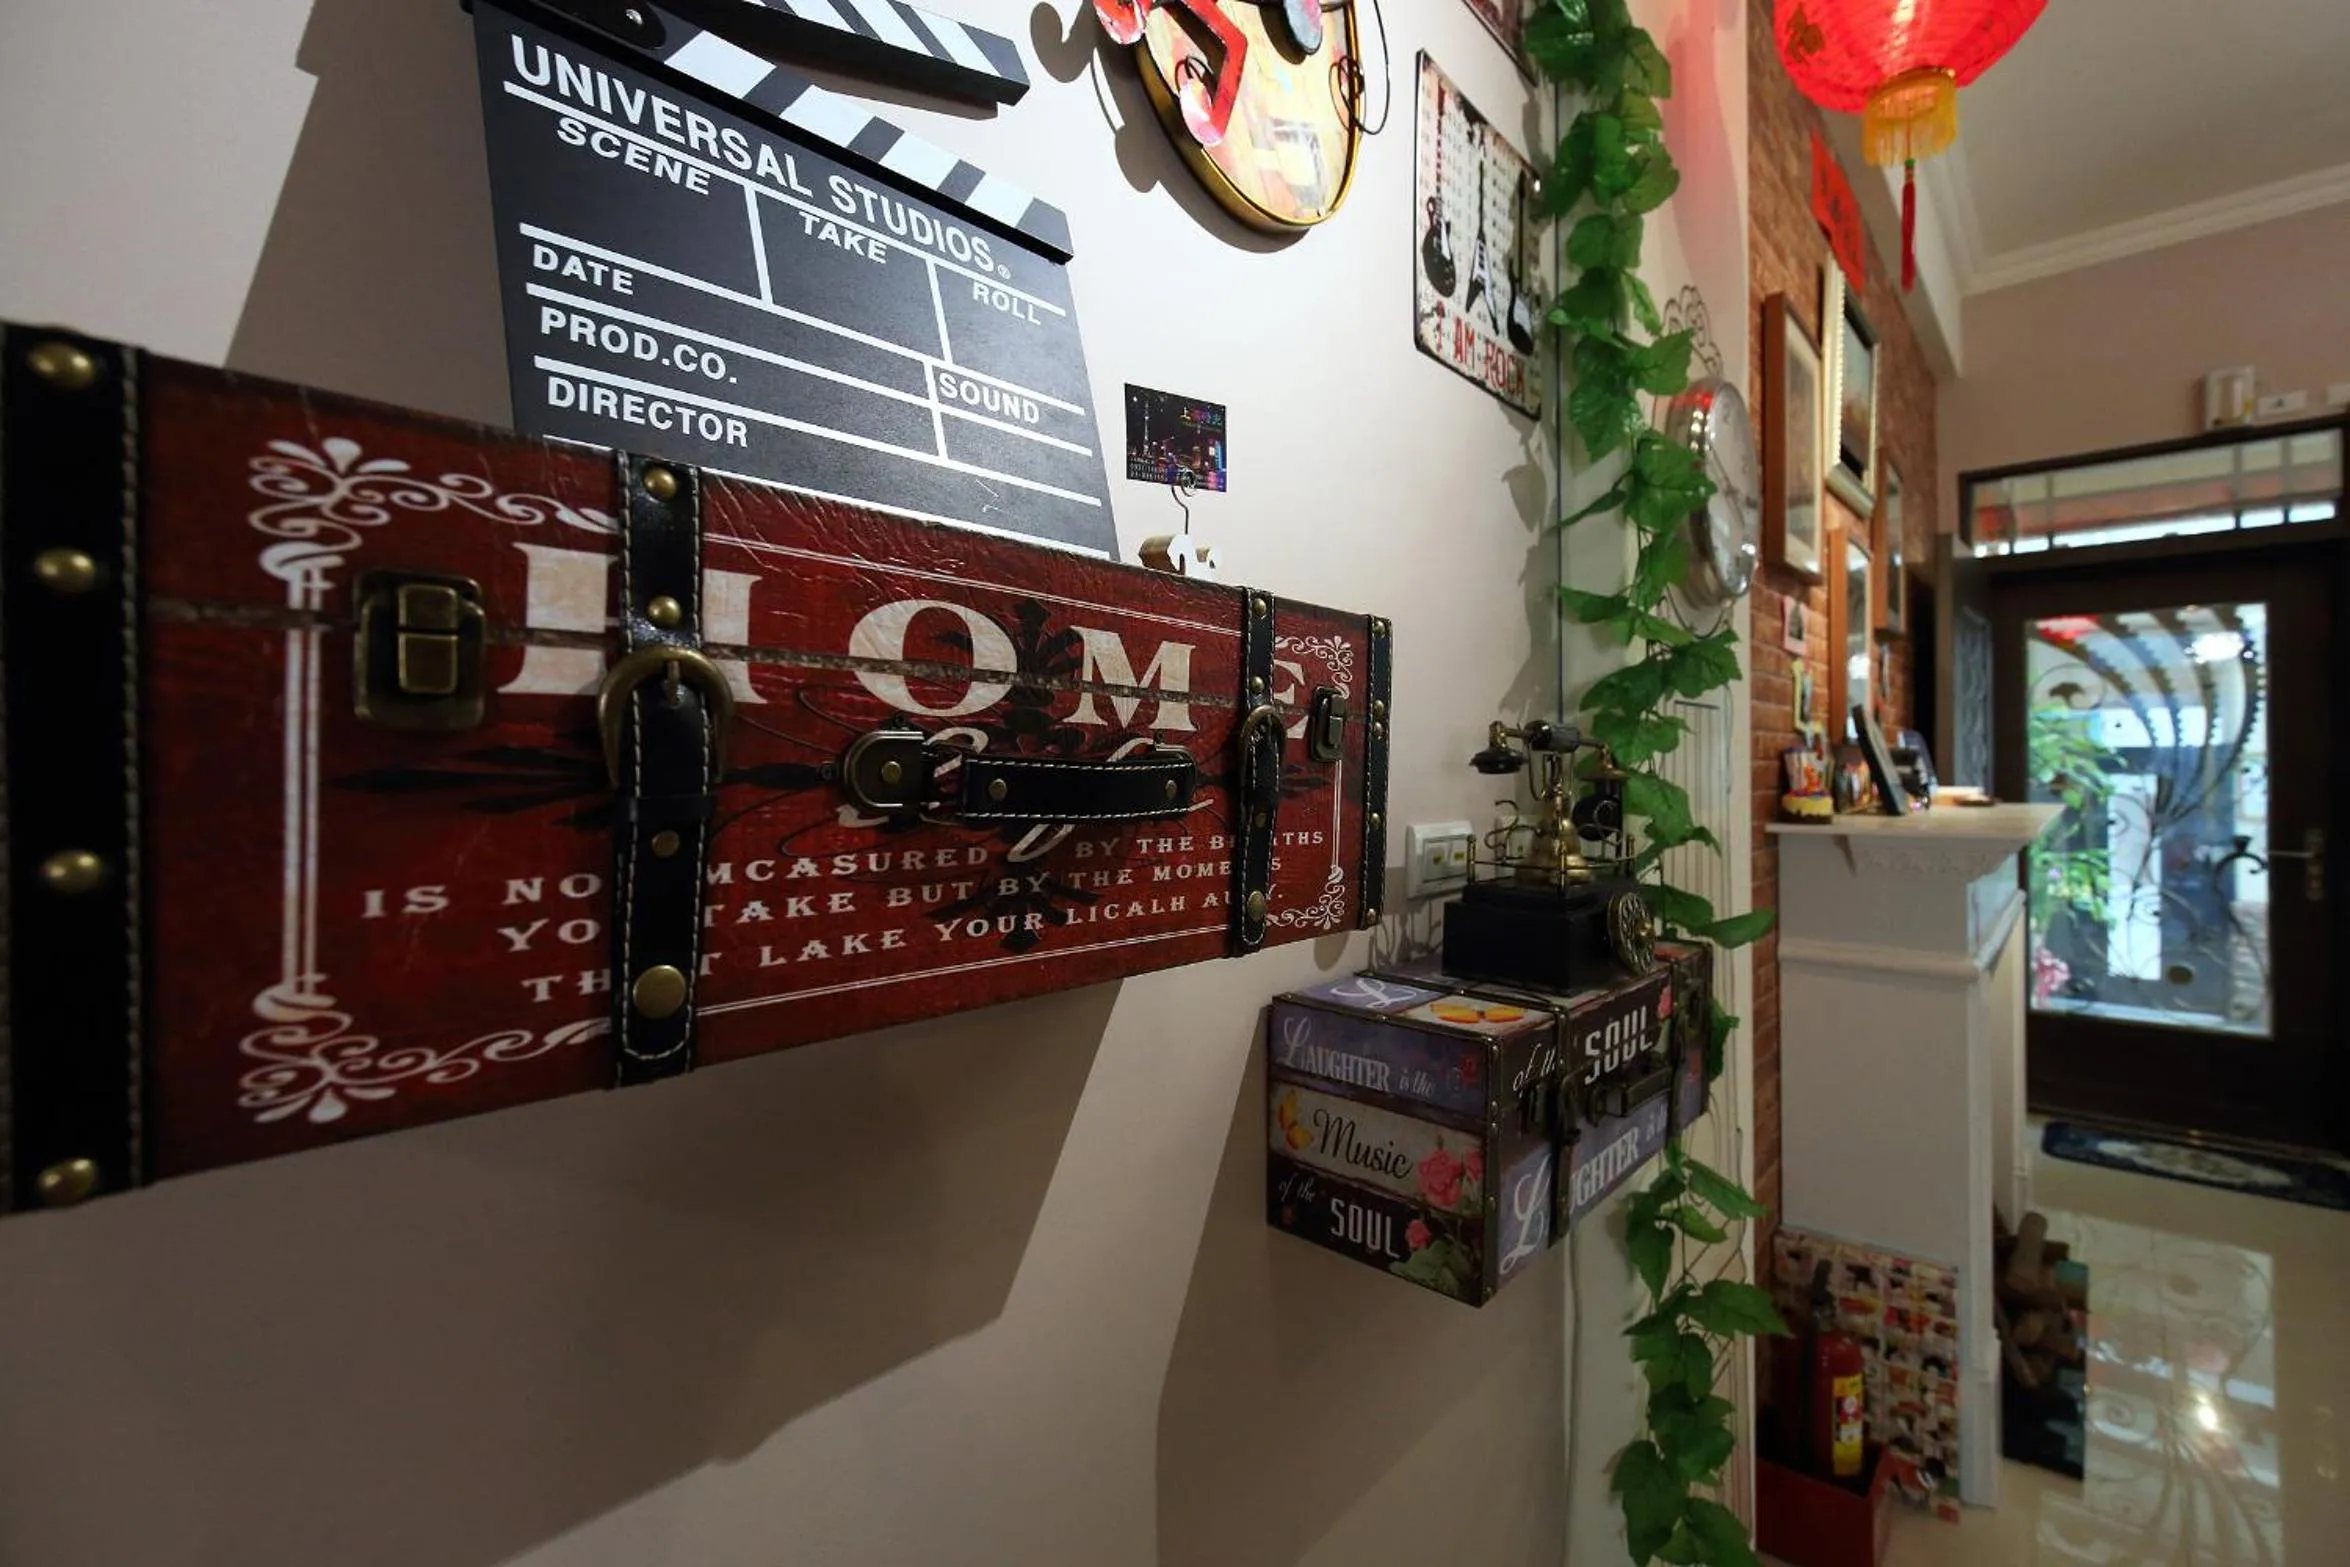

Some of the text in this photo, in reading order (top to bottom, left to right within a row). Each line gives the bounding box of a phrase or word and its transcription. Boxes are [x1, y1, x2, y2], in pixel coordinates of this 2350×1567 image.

[511, 35, 813, 198] UNIVERSAL
[557, 117, 709, 195] SCENE
[533, 244, 634, 295] DATE
[799, 211, 887, 264] TAKE
[973, 281, 1041, 325] ROLL
[541, 306, 737, 383] PROD.CO.
[548, 376, 748, 448] DIRECTOR
[938, 372, 1039, 424] SOUND
[361, 884, 450, 918] IS
[505, 873, 602, 905] NO
[1075, 838, 1120, 858] BY
[1136, 837, 1194, 854] THE
[498, 919, 601, 952] YO
[703, 892, 857, 928] TAKE
[887, 881, 974, 907] BUT
[998, 871, 1050, 896] BY
[1068, 869, 1134, 890] THE
[758, 928, 908, 967] LAKE
[934, 916, 1045, 942] YOUR
[1313, 1109, 1415, 1179] Music
[1330, 1197, 1401, 1259] SOUL
